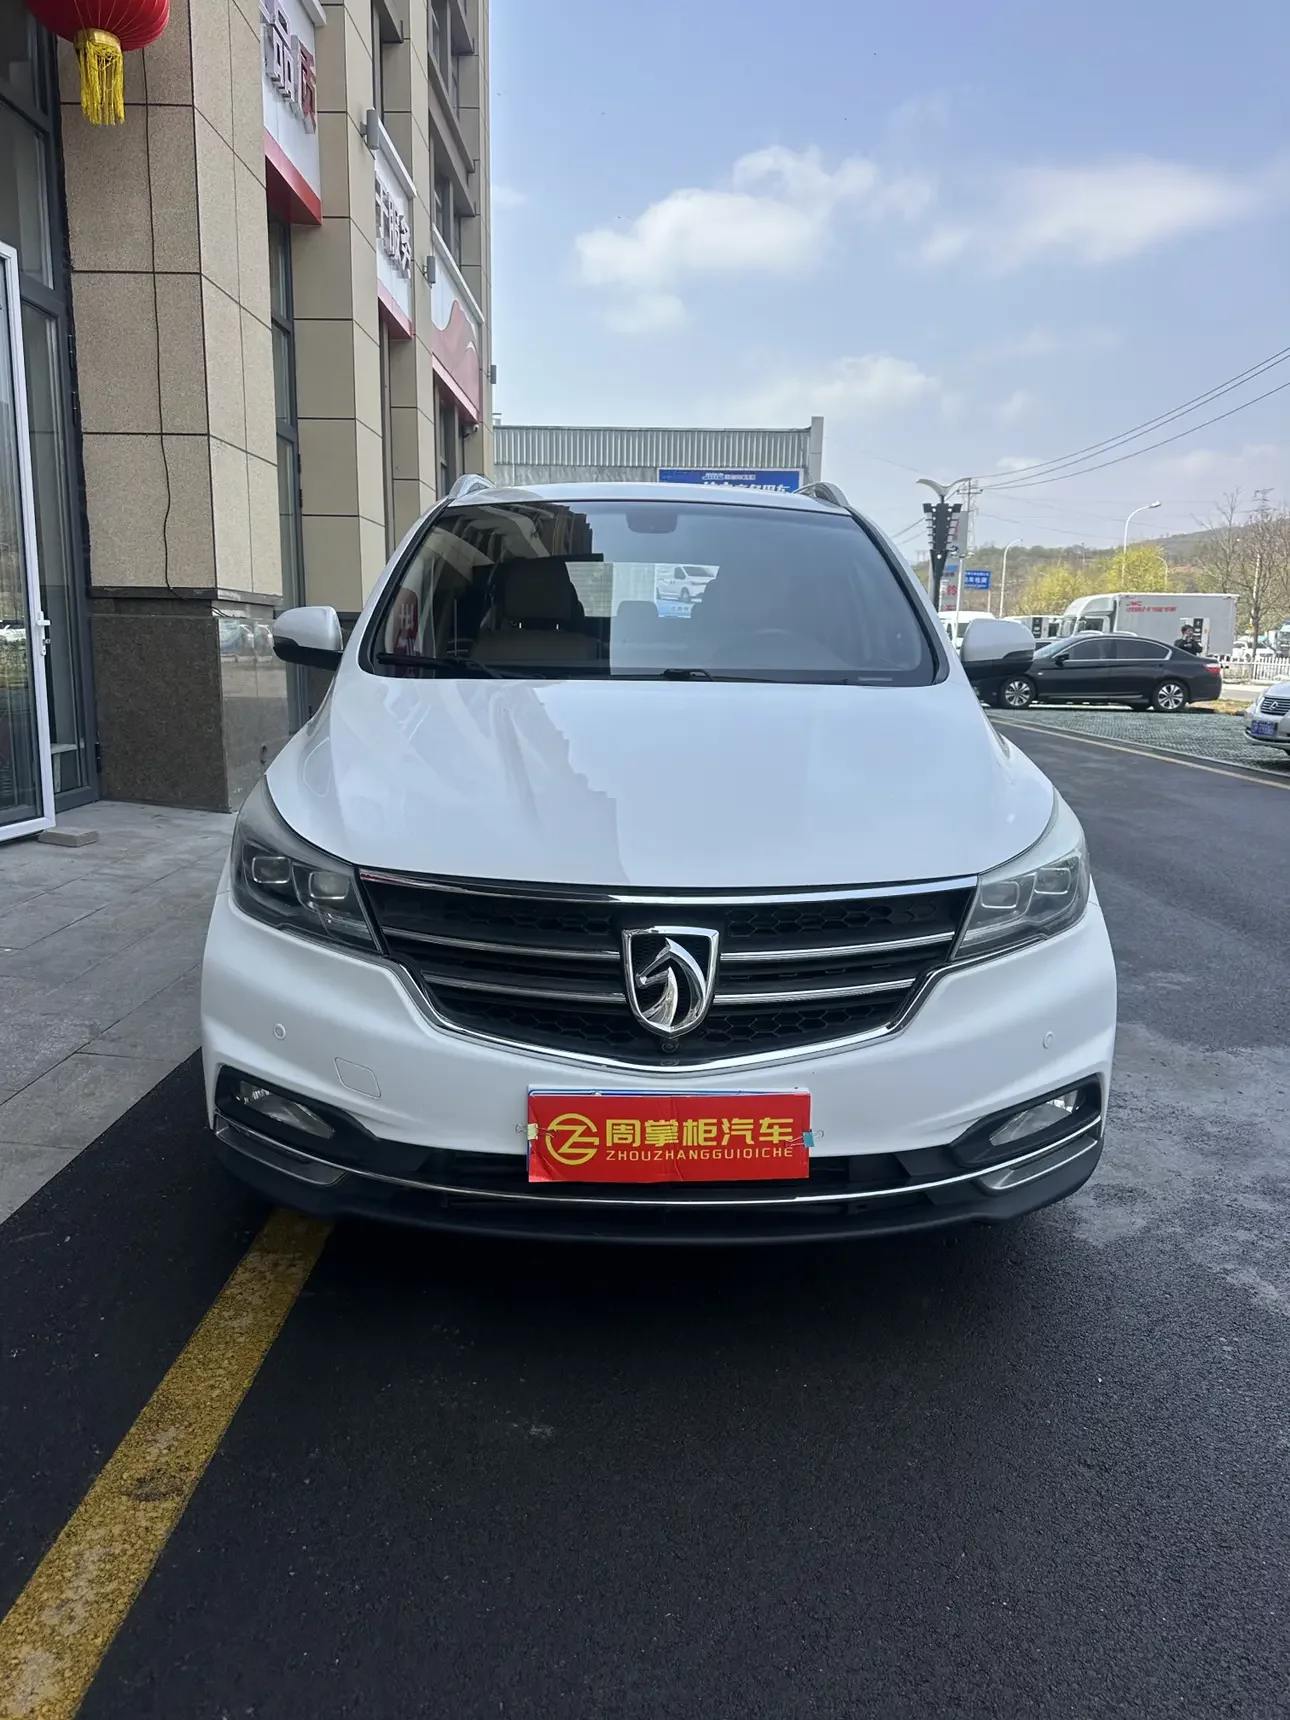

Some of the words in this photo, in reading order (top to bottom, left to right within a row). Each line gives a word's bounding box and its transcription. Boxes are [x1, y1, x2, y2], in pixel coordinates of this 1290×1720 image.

[606, 1117, 794, 1147] 周掌柜汽车
[606, 1147, 793, 1161] ZHOUZHANGGUIQICHE
